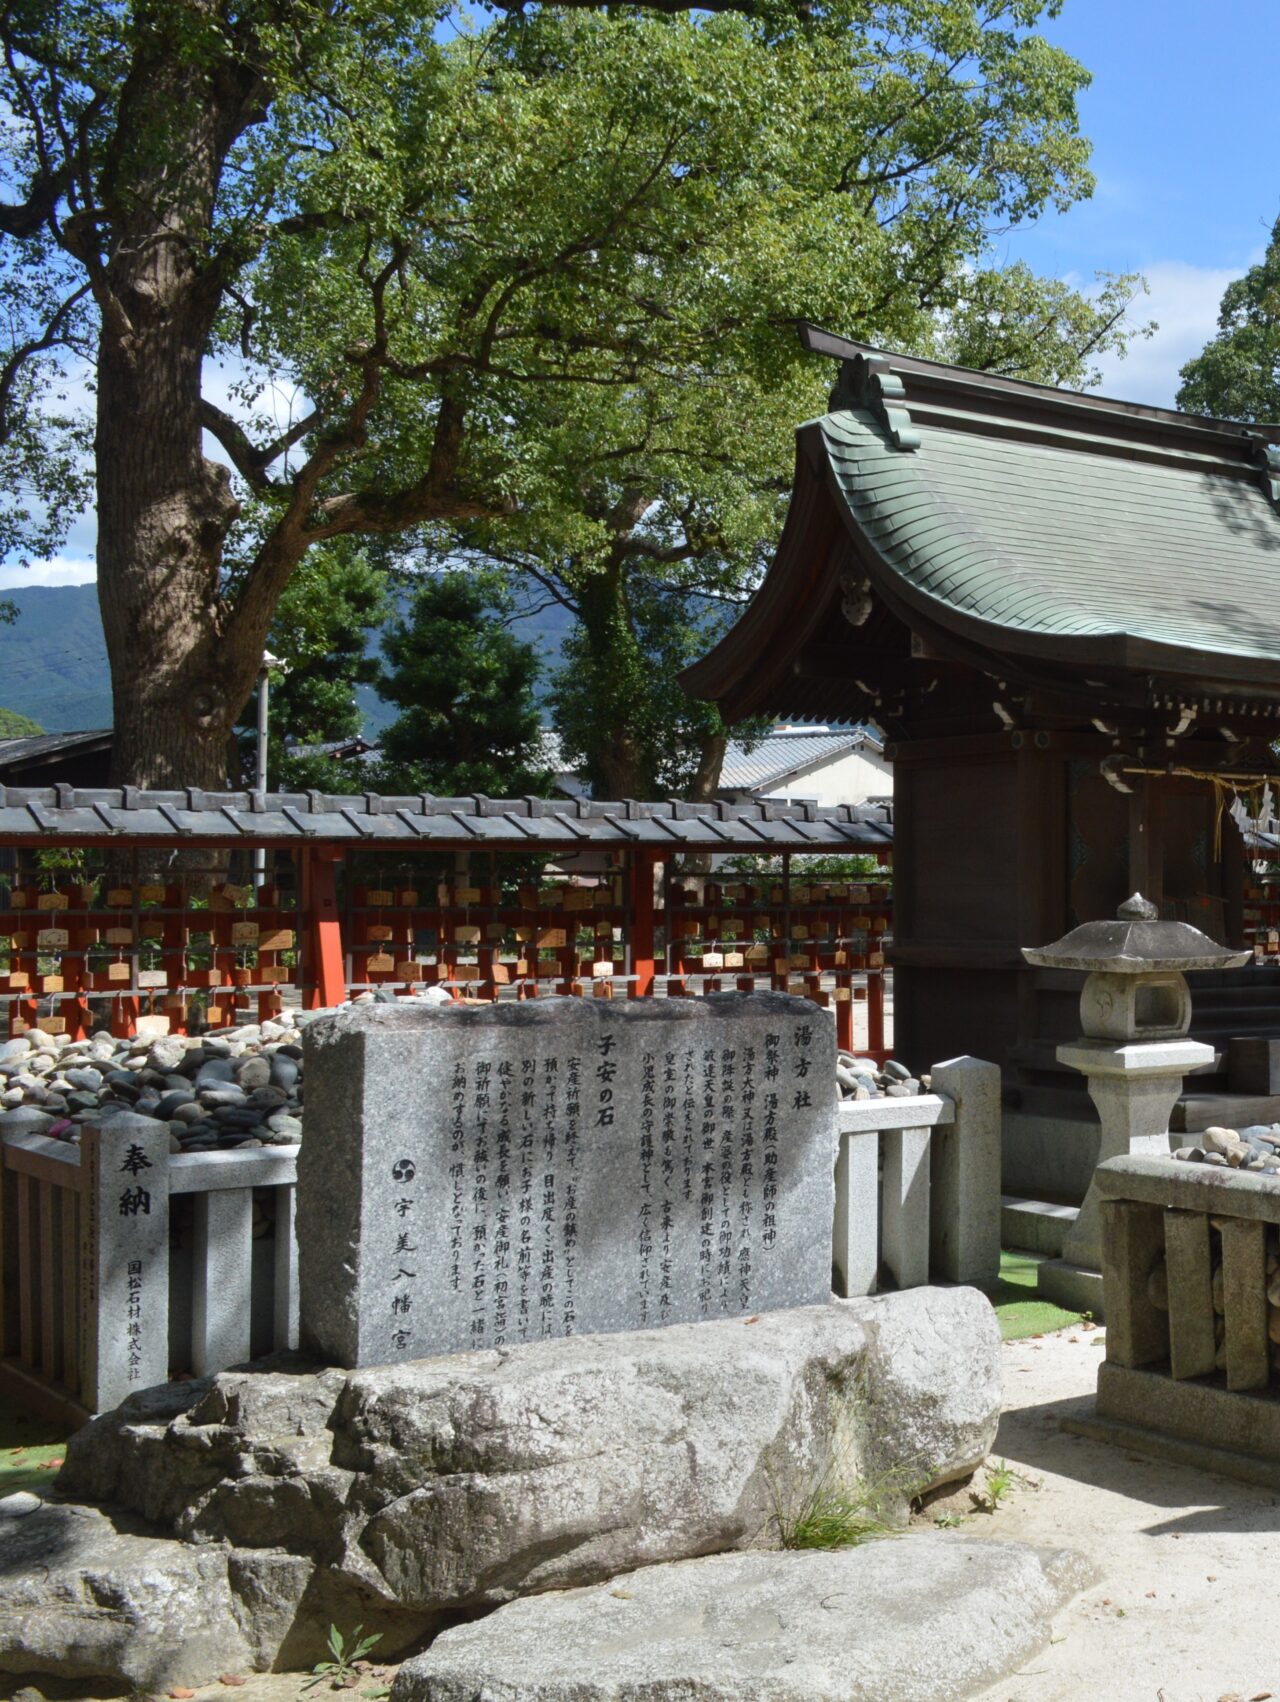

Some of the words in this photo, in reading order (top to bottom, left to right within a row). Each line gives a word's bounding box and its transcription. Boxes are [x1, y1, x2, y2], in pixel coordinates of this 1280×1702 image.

[594, 1034, 617, 1128] 子安の石
[764, 1033, 780, 1082] 御祭神
[792, 1025, 813, 1110] 湯方社
[119, 1143, 153, 1217] 奉納
[391, 1198, 417, 1350] 宇美八幡宮
[126, 1260, 142, 1382] 国松石材株式会社
